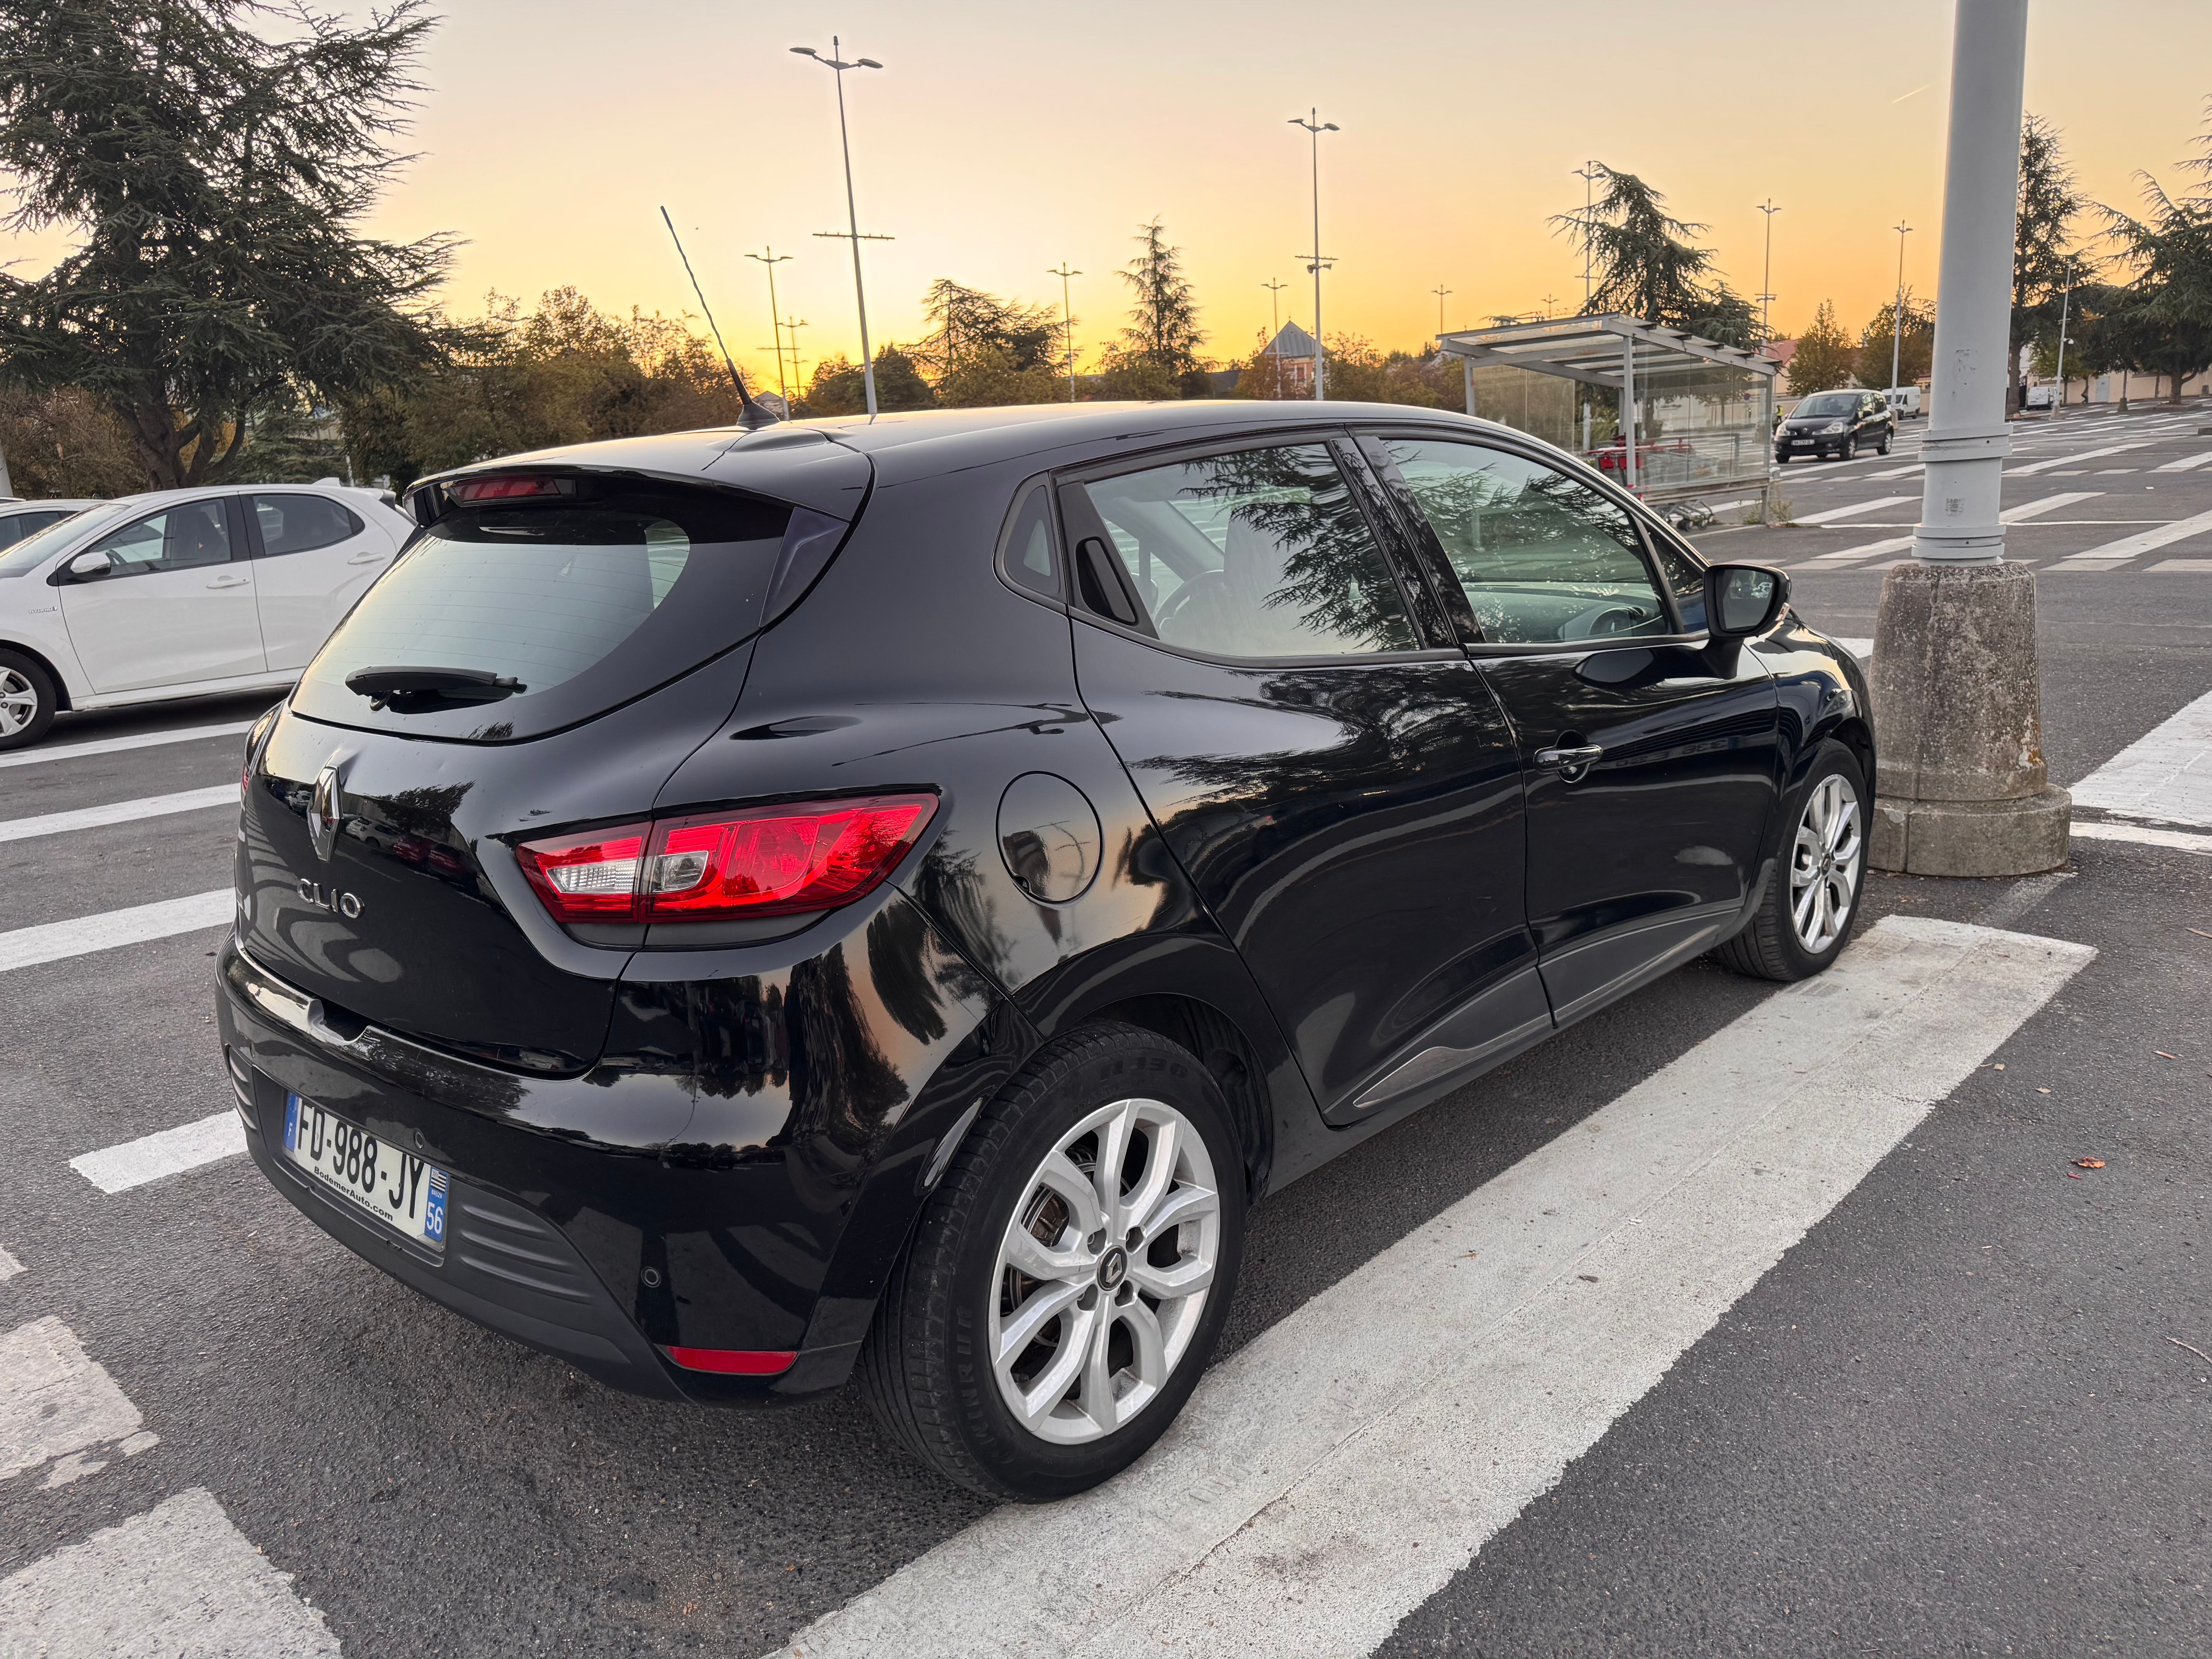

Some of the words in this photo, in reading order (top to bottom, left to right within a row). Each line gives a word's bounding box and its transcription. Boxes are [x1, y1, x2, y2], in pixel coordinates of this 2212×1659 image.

[297, 878, 365, 918] CLIO
[288, 1122, 293, 1137] F
[297, 1104, 424, 1219] FD-988-JY
[314, 1166, 393, 1221] BodemerAuto.com
[427, 1201, 443, 1234] 56
